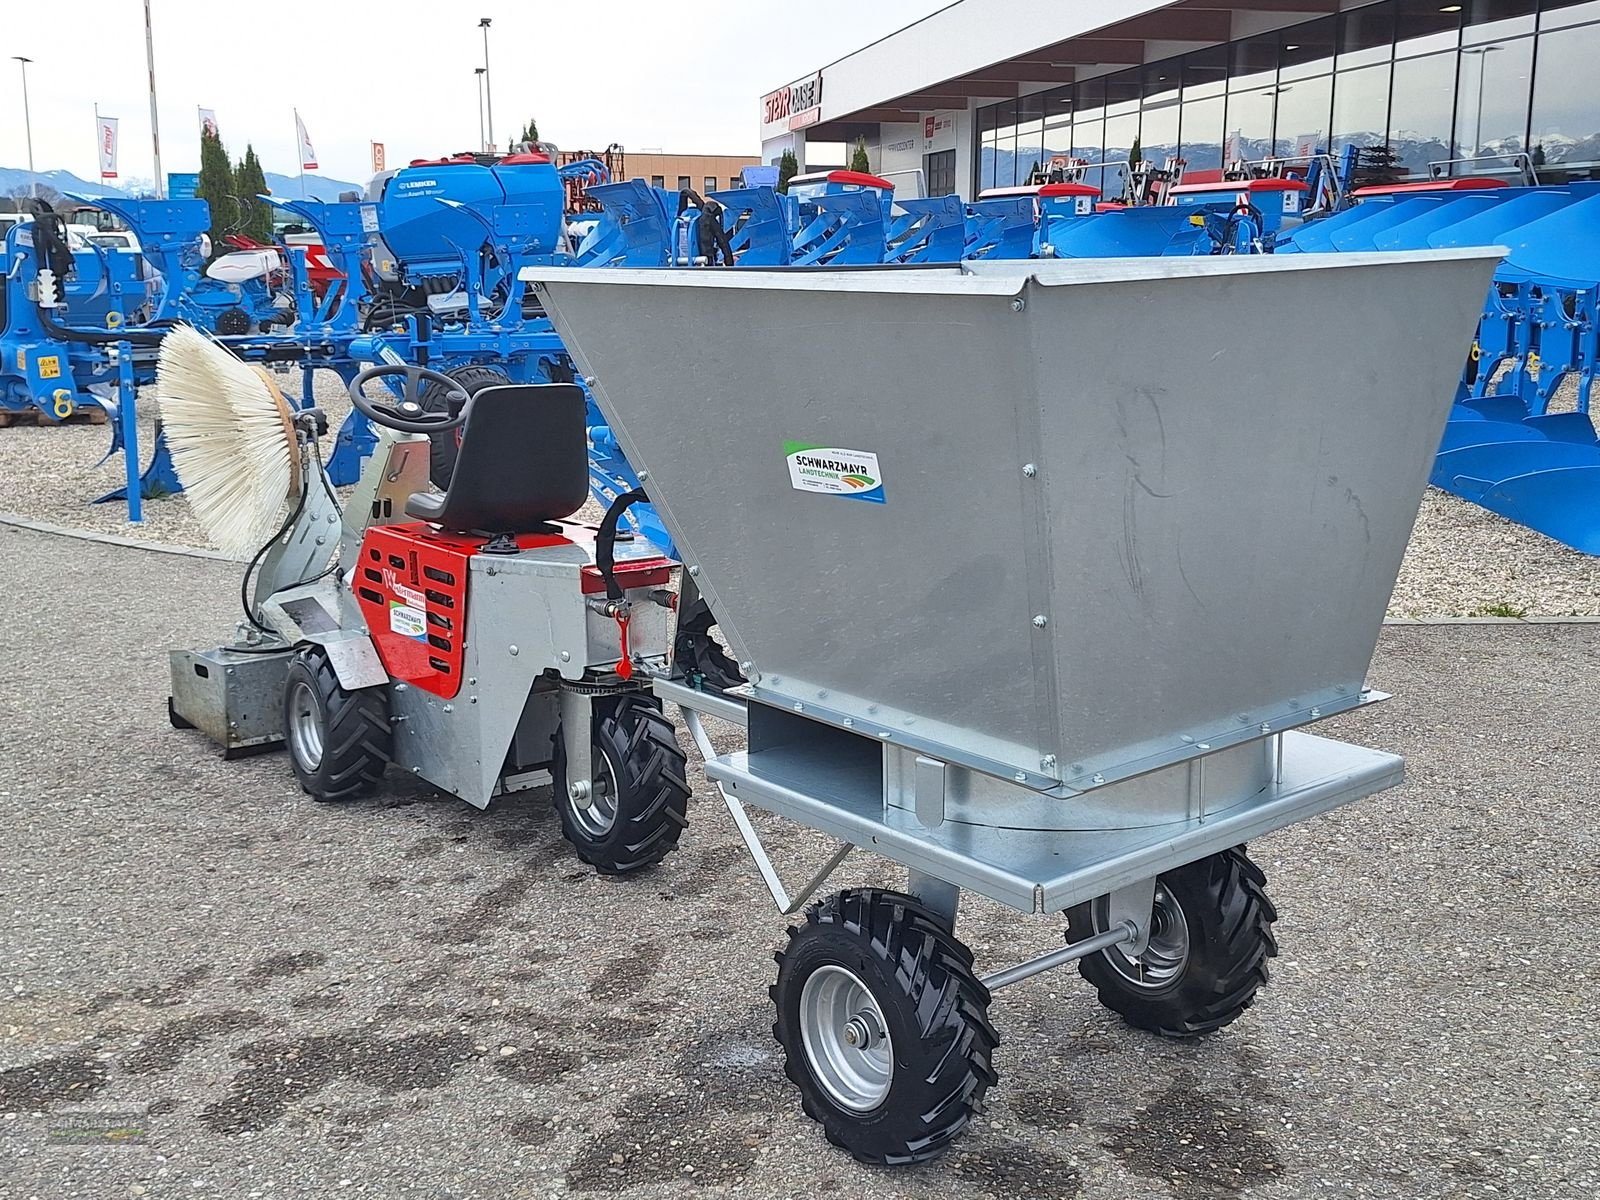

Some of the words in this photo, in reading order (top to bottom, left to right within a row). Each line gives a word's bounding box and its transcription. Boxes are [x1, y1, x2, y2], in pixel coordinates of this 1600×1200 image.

[406, 180, 437, 189] LEMKEN
[796, 455, 868, 475] SCHWARZMAYR
[799, 467, 841, 480] LANDTECHNIK
